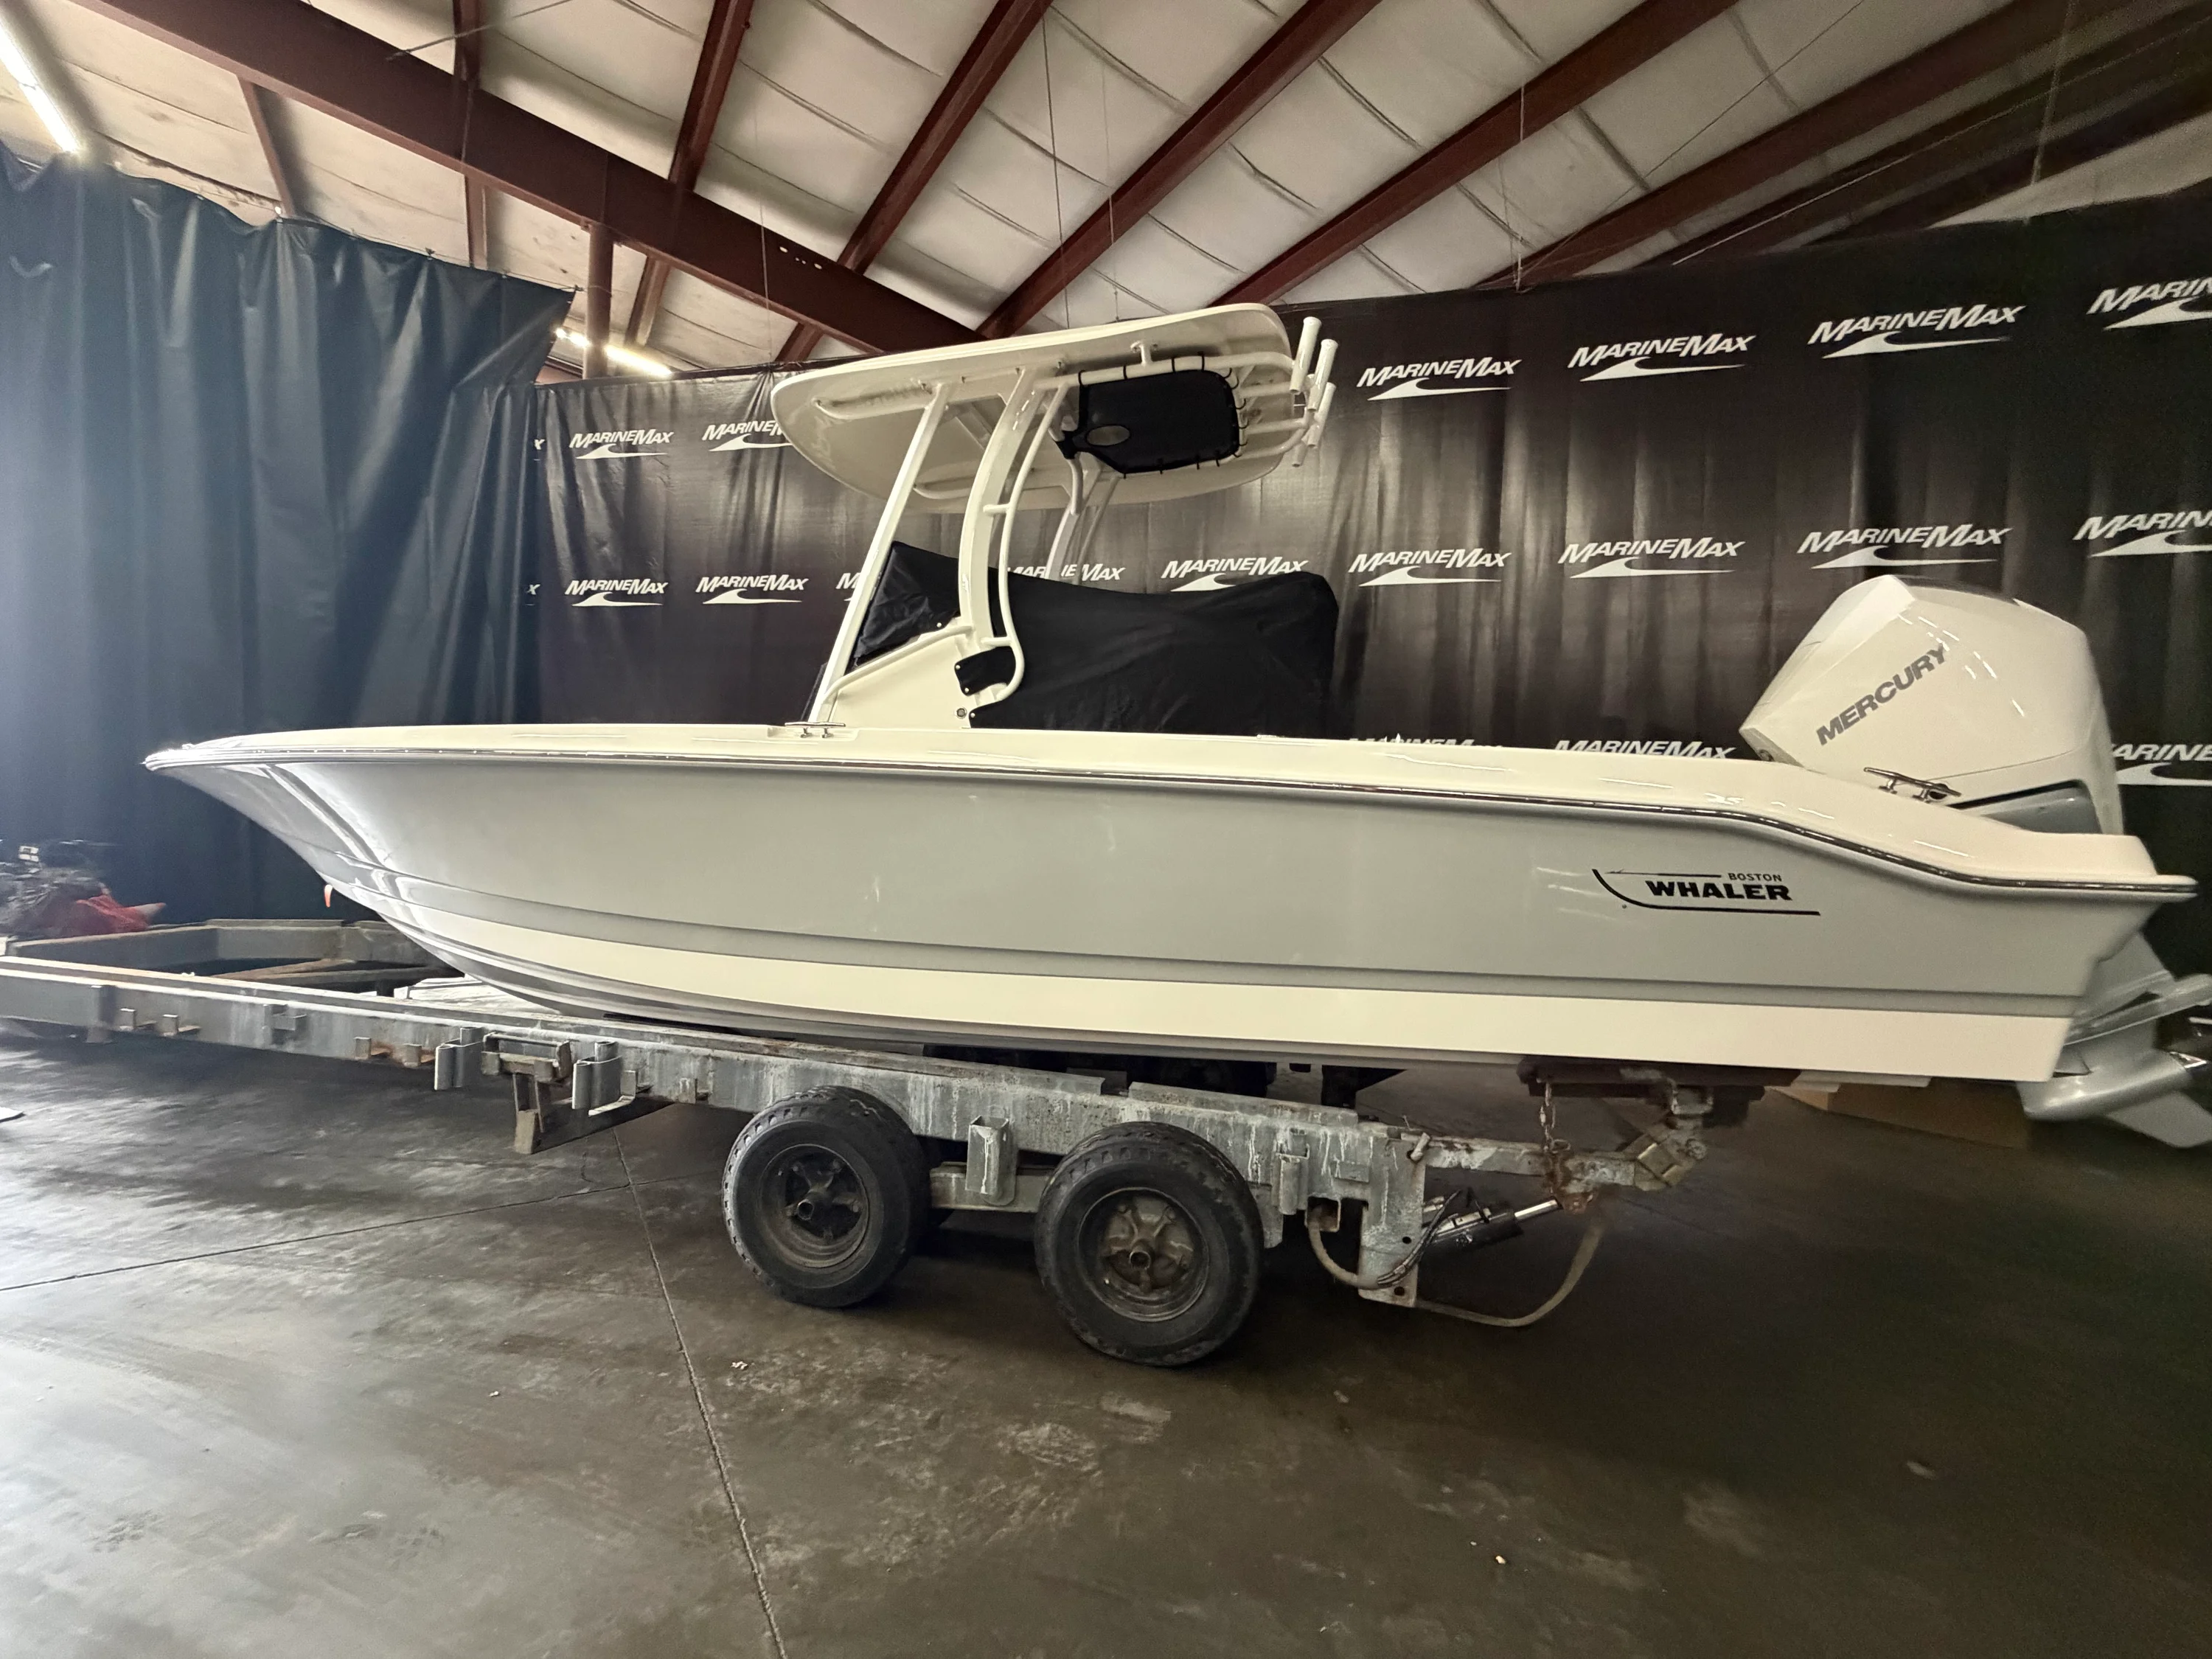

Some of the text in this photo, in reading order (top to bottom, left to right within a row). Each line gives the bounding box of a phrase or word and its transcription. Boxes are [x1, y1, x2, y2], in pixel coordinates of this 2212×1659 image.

[2073, 509, 2212, 540] MARIN
[1816, 643, 1945, 745] MERCURY
[2111, 743, 2212, 761] ARINE
[1728, 872, 1783, 883] BOSTON
[1645, 880, 1793, 901] WHALER
